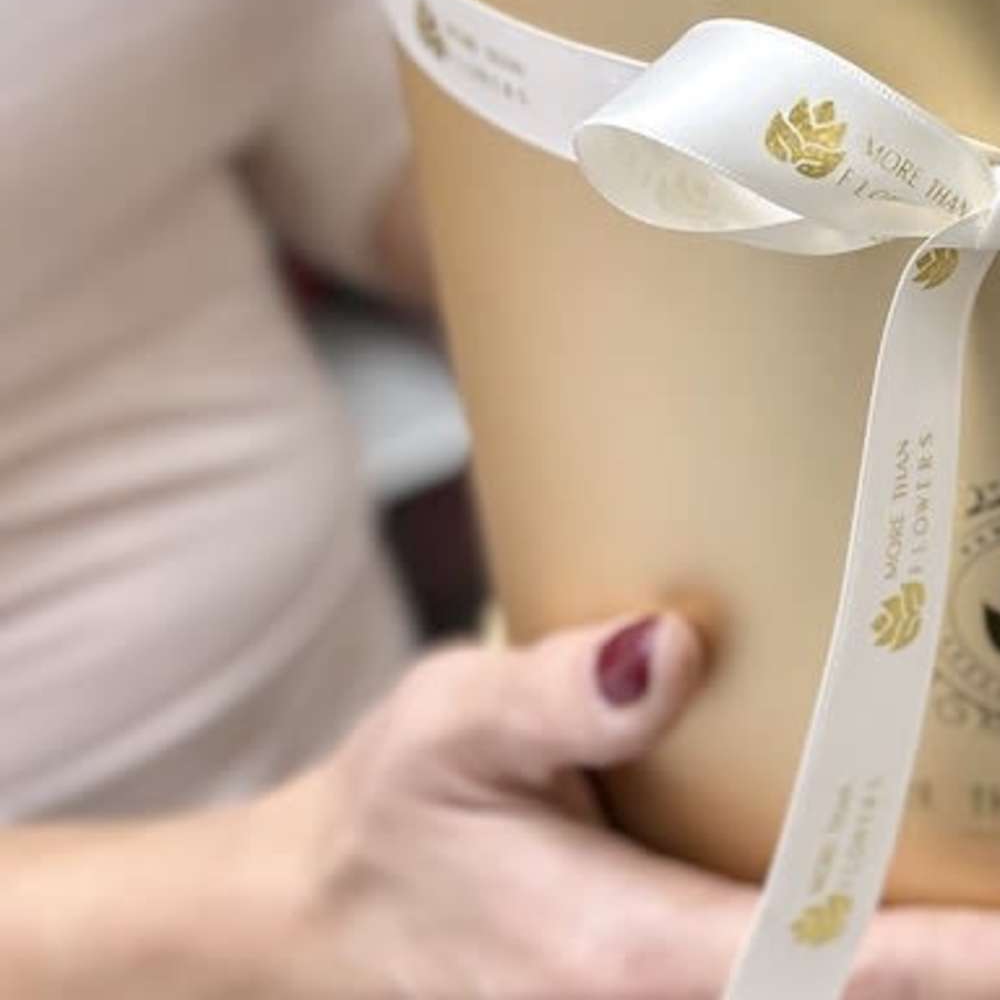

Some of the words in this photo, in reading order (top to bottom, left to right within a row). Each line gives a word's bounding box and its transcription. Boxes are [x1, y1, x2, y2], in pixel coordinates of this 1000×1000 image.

[866, 135, 917, 189] MORE
[924, 177, 972, 217] THAN
[892, 438, 909, 501] THAN
[907, 431, 934, 575] FLOWERS
[882, 514, 905, 581] MORE
